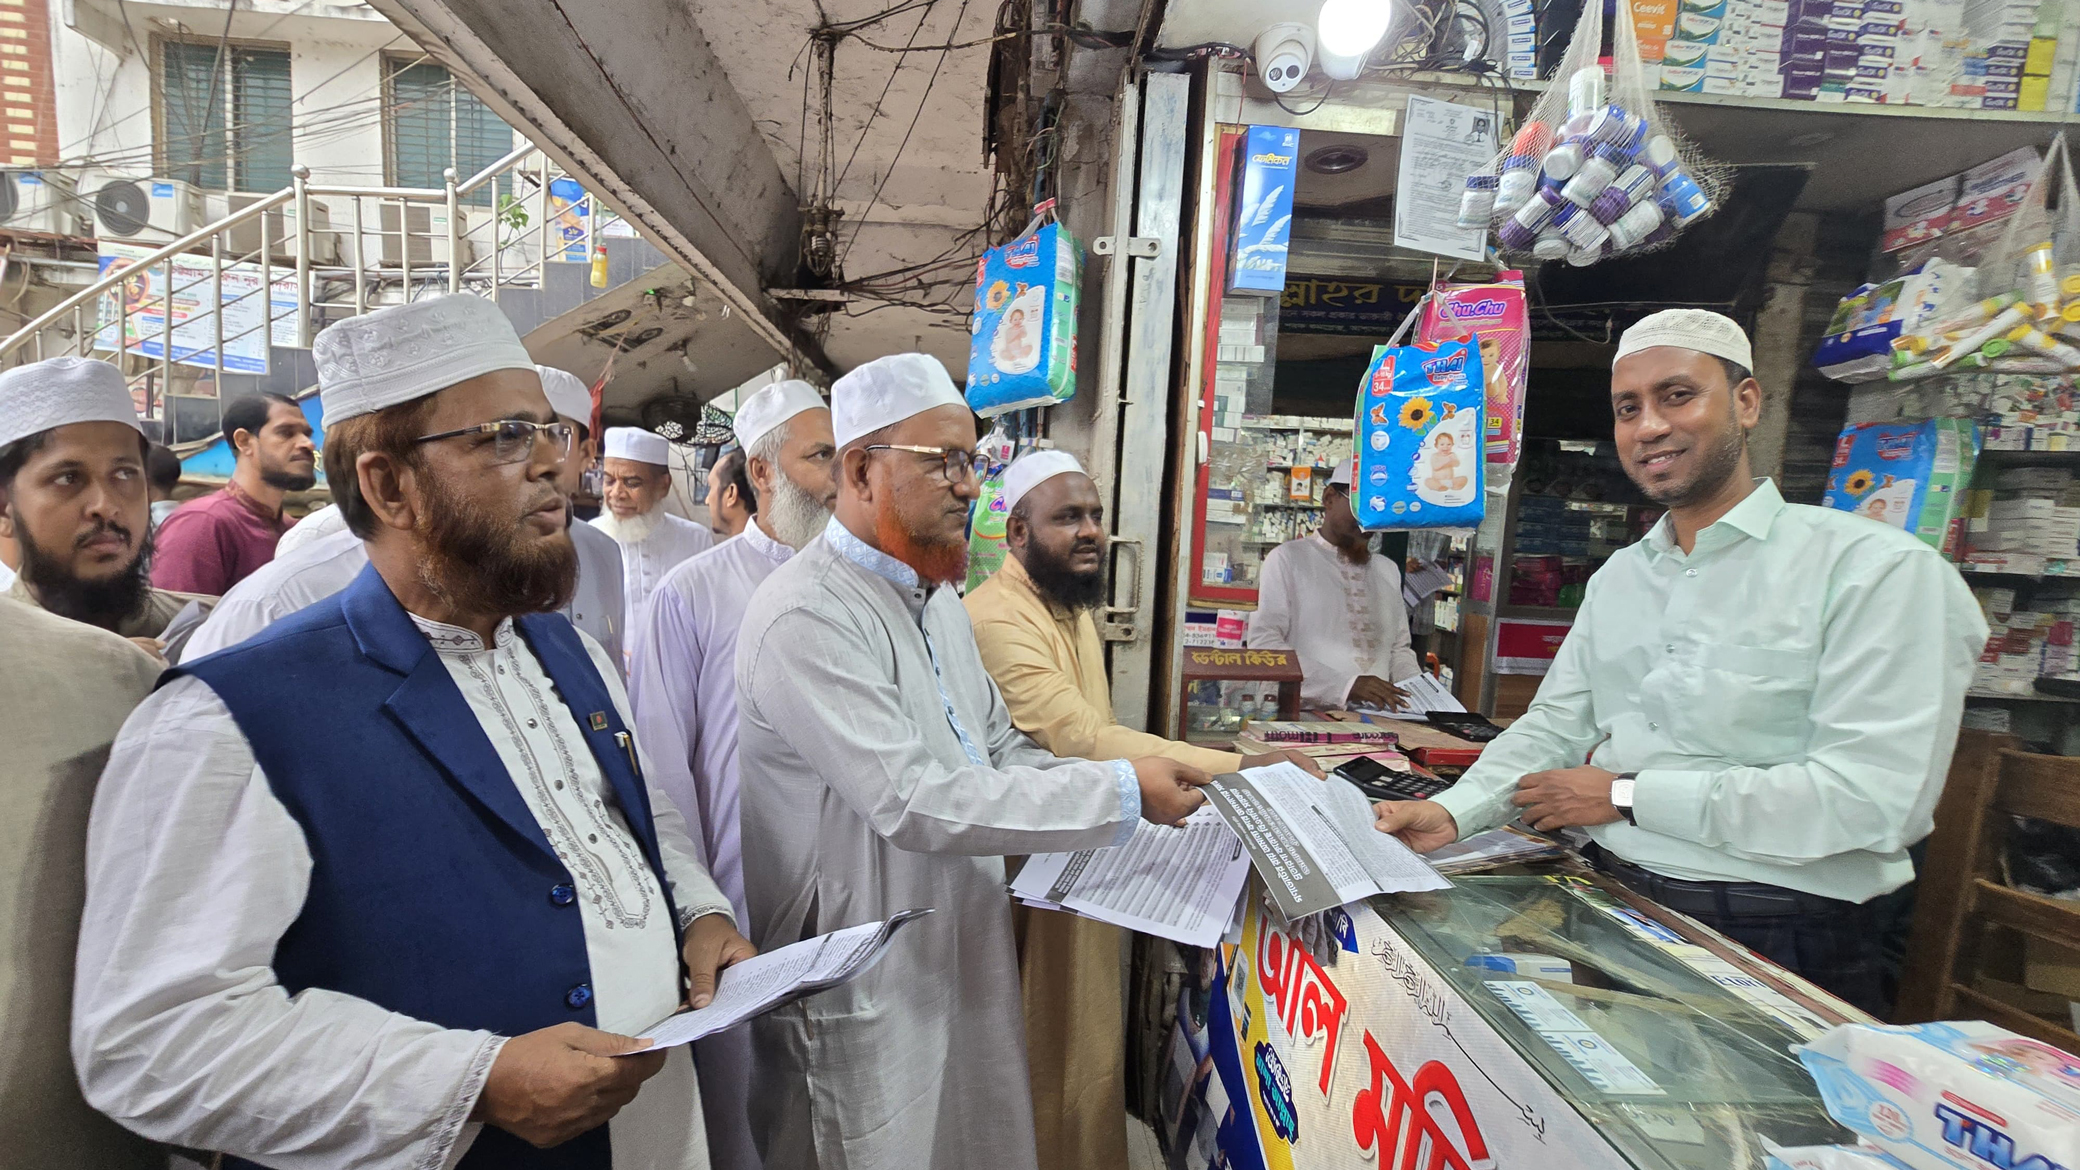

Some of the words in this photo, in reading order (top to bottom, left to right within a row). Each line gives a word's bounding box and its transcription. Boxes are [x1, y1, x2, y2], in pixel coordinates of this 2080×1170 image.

[1633, 1, 1667, 15] Ceevit
[1280, 279, 1384, 308] ল্লাহর
[1424, 356, 1464, 374] THAI
[1373, 381, 1384, 392] 34
